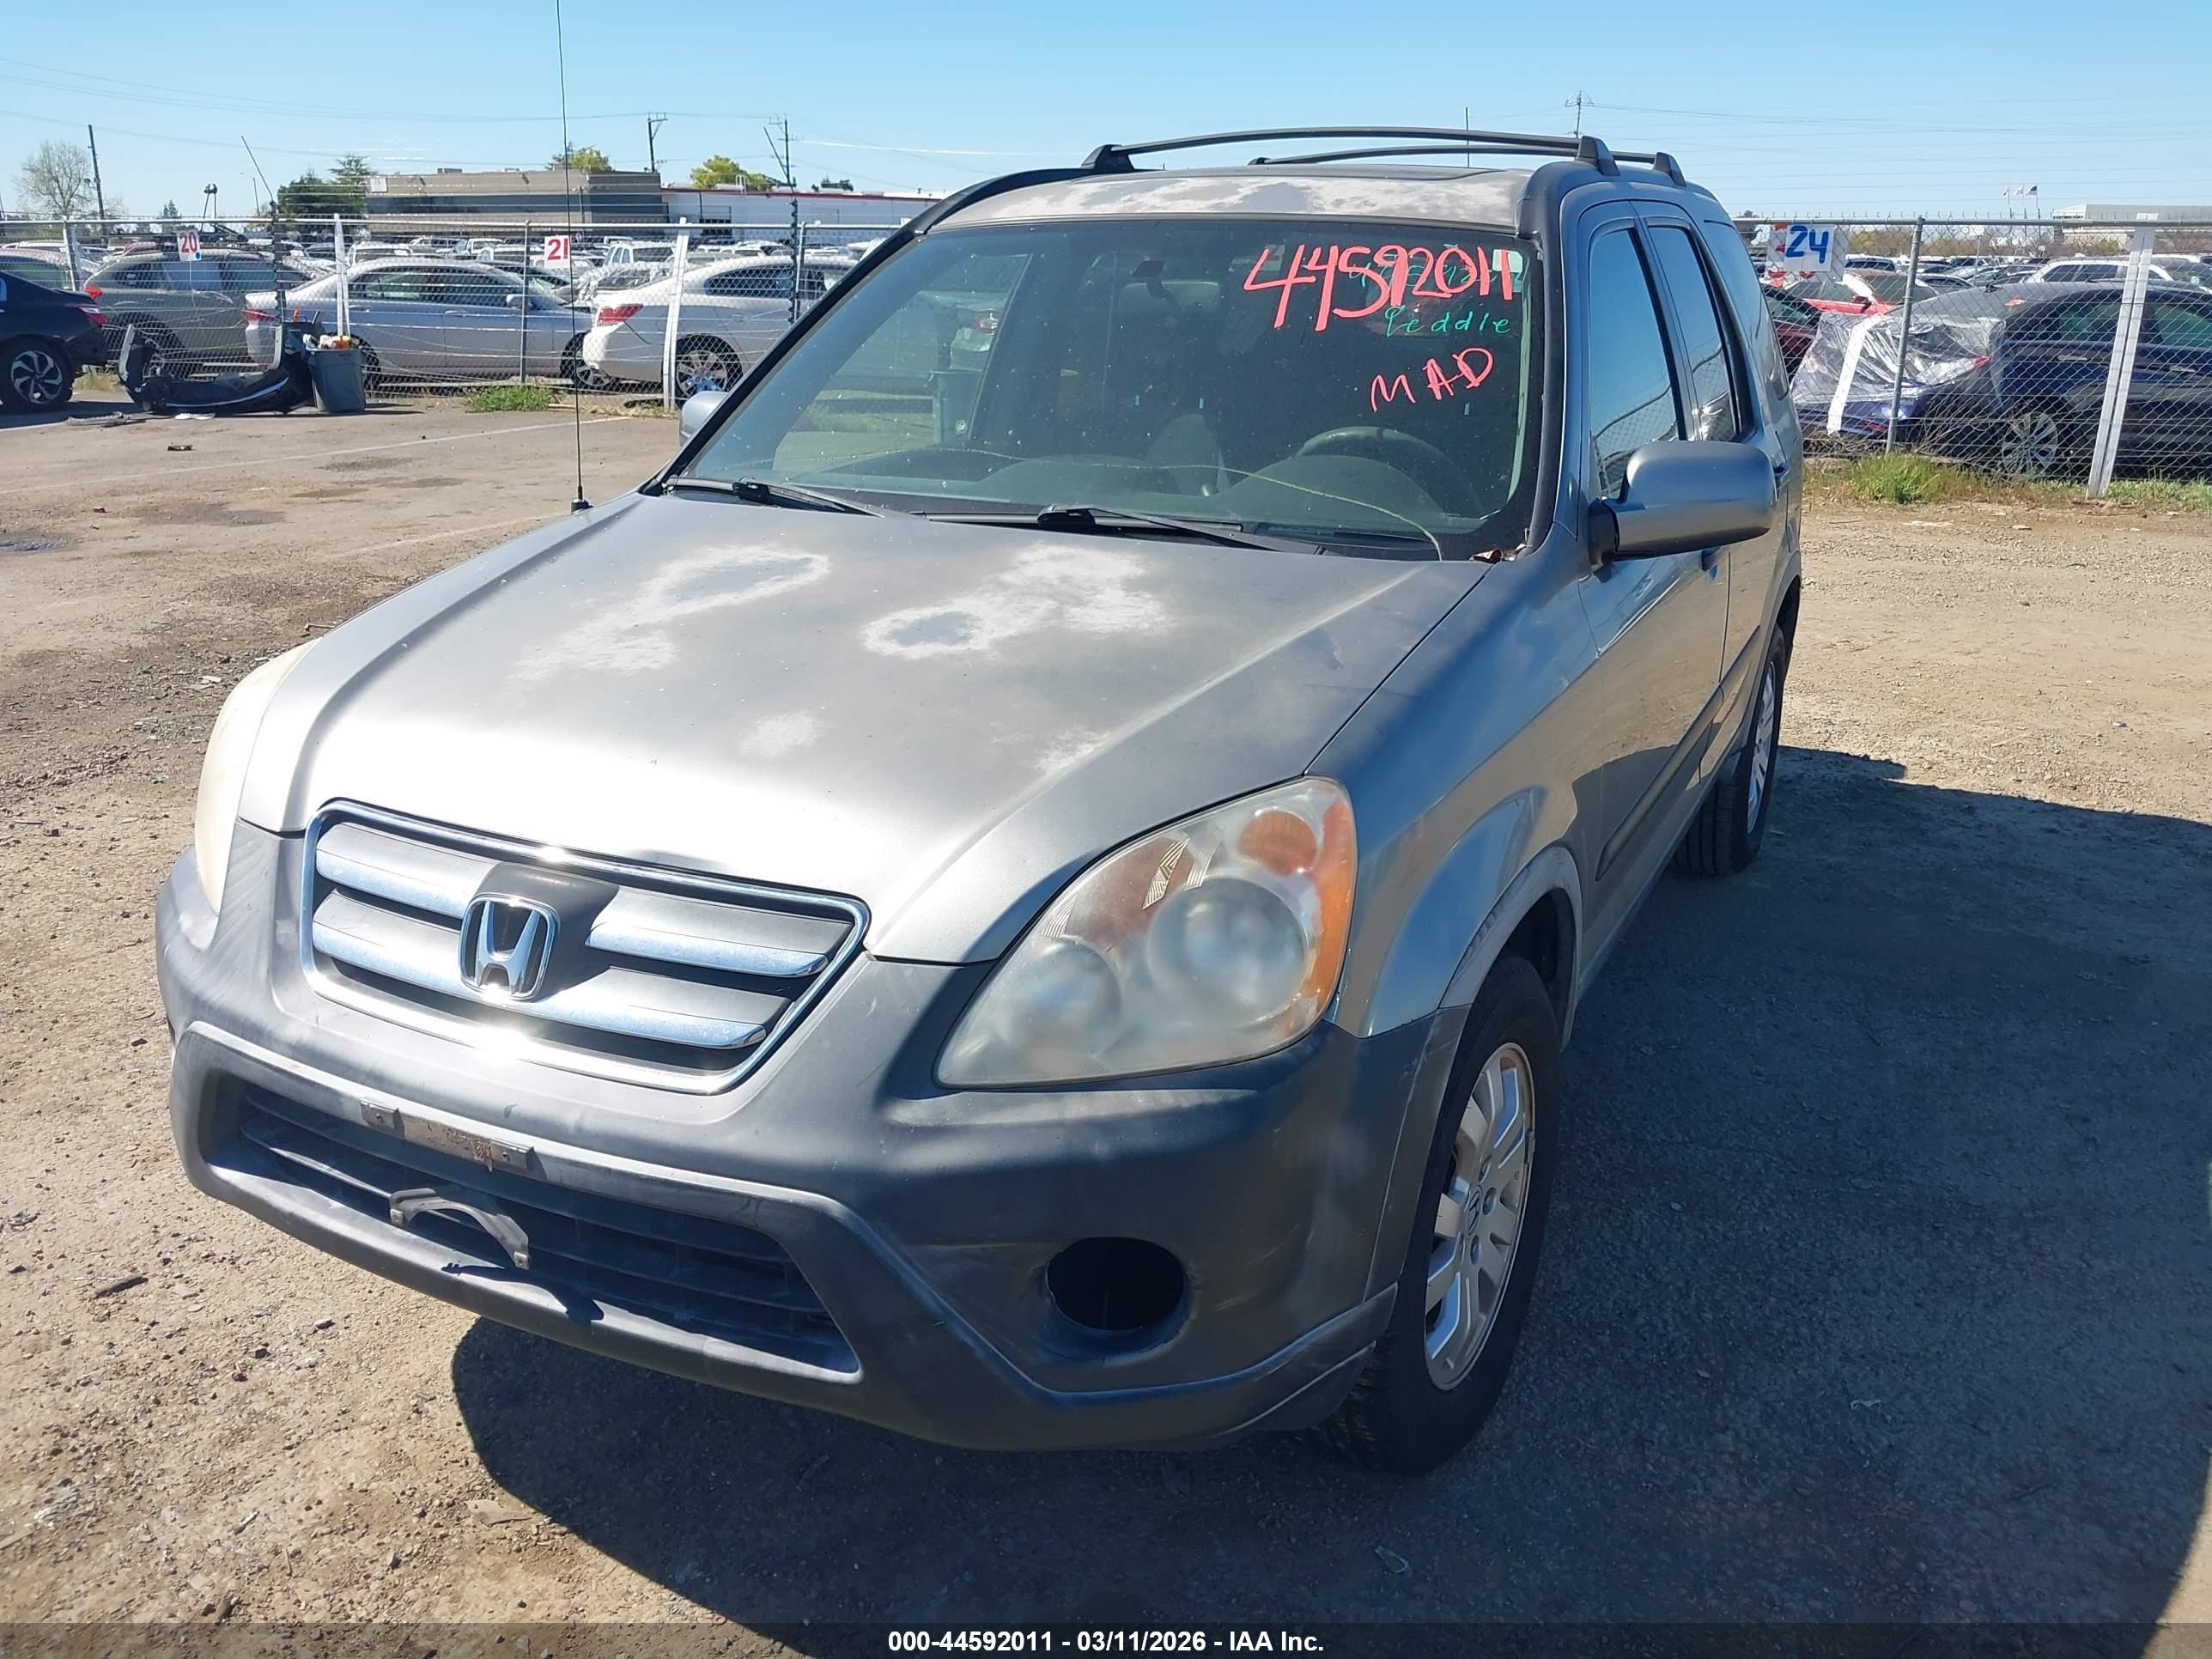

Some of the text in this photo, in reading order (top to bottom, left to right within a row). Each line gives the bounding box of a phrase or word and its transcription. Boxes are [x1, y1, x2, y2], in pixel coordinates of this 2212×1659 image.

[179, 232, 198, 253] 20
[547, 238, 568, 260] 21
[1785, 224, 1829, 264] 24
[1243, 244, 1513, 331] 44592011
[1370, 347, 1494, 412] MAD
